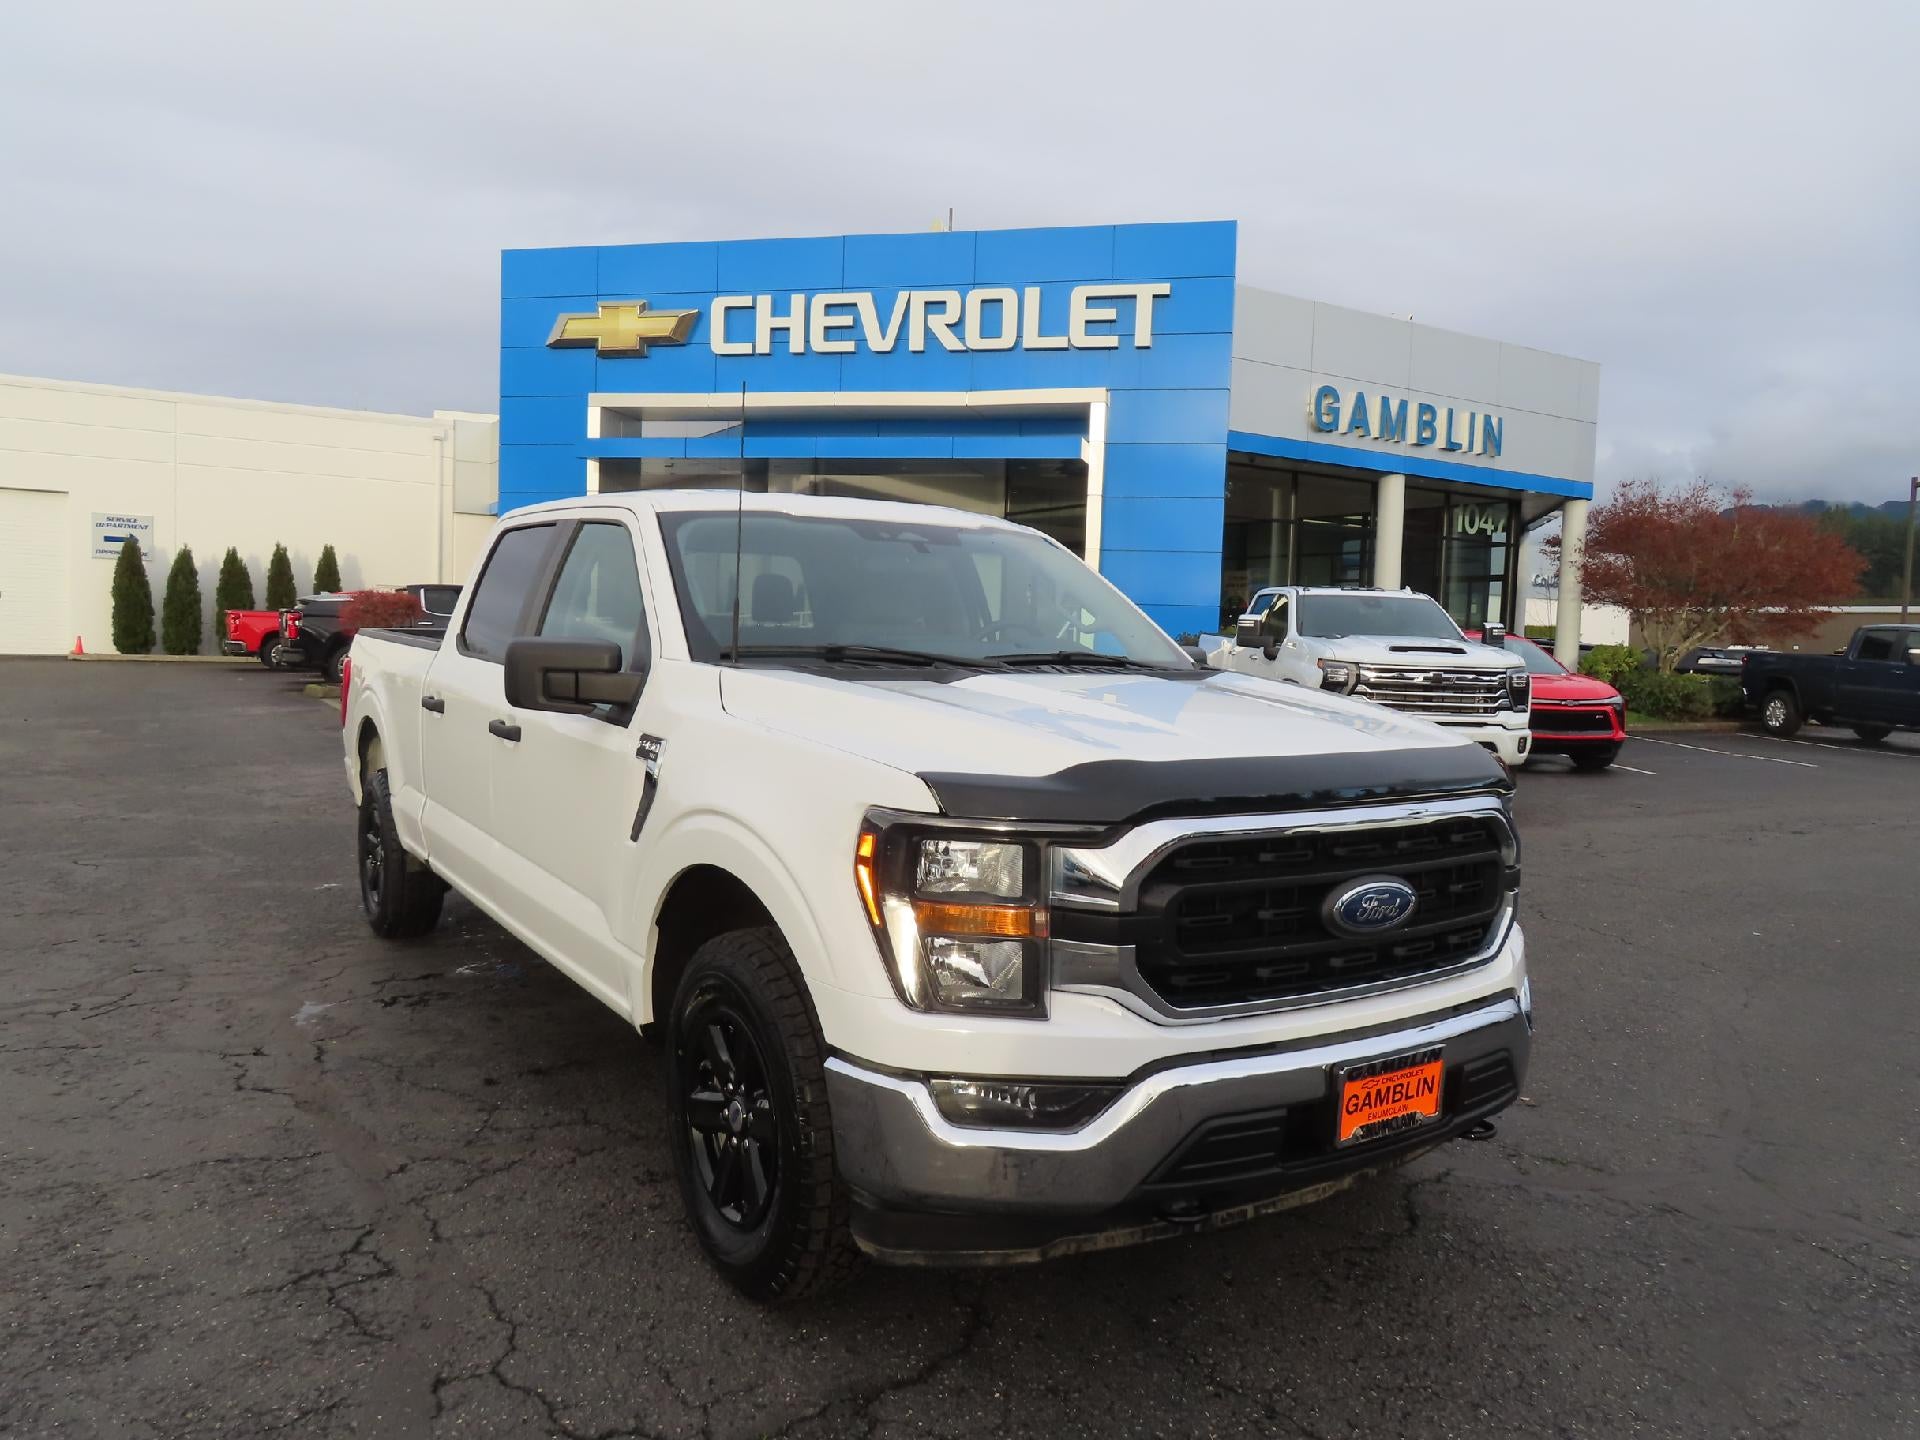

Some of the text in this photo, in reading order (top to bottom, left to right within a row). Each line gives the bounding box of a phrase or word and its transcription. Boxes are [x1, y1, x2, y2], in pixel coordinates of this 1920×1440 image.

[710, 283, 1171, 355] CHEVROLET
[1312, 384, 1503, 458] GAMBLIN
[95, 522, 149, 530] DEPARTMENT
[1357, 893, 1401, 920] Ford
[1380, 1068, 1424, 1085] CHEVROLET
[1345, 1075, 1435, 1116] GAMBLIN
[1367, 1103, 1409, 1121] ENUMCLAW
